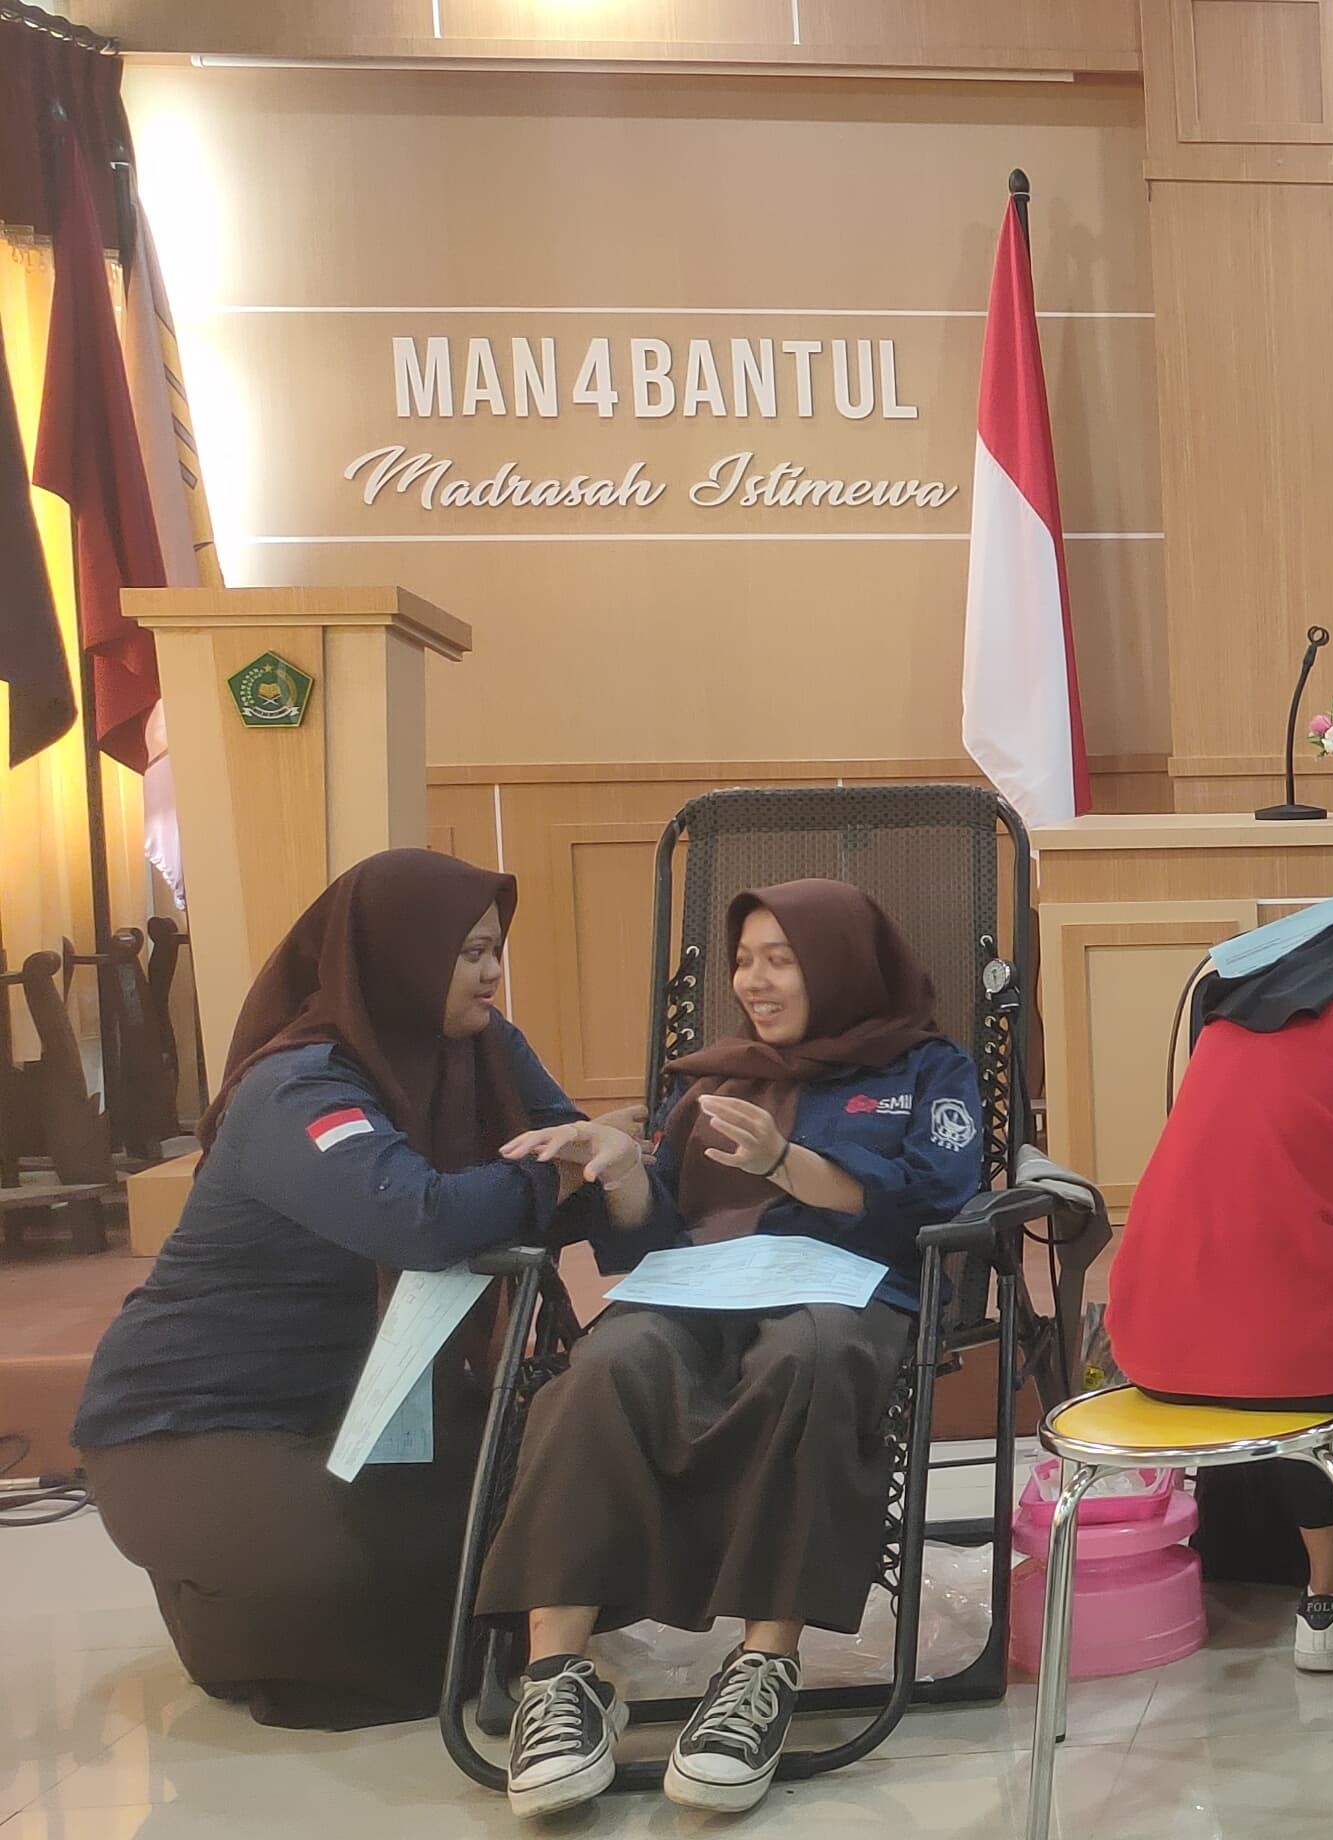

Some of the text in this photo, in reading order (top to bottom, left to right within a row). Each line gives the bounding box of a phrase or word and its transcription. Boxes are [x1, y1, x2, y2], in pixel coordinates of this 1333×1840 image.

[392, 336, 919, 420] MAN 4 BANTUL
[344, 445, 958, 511] Madrasah Istimewa
